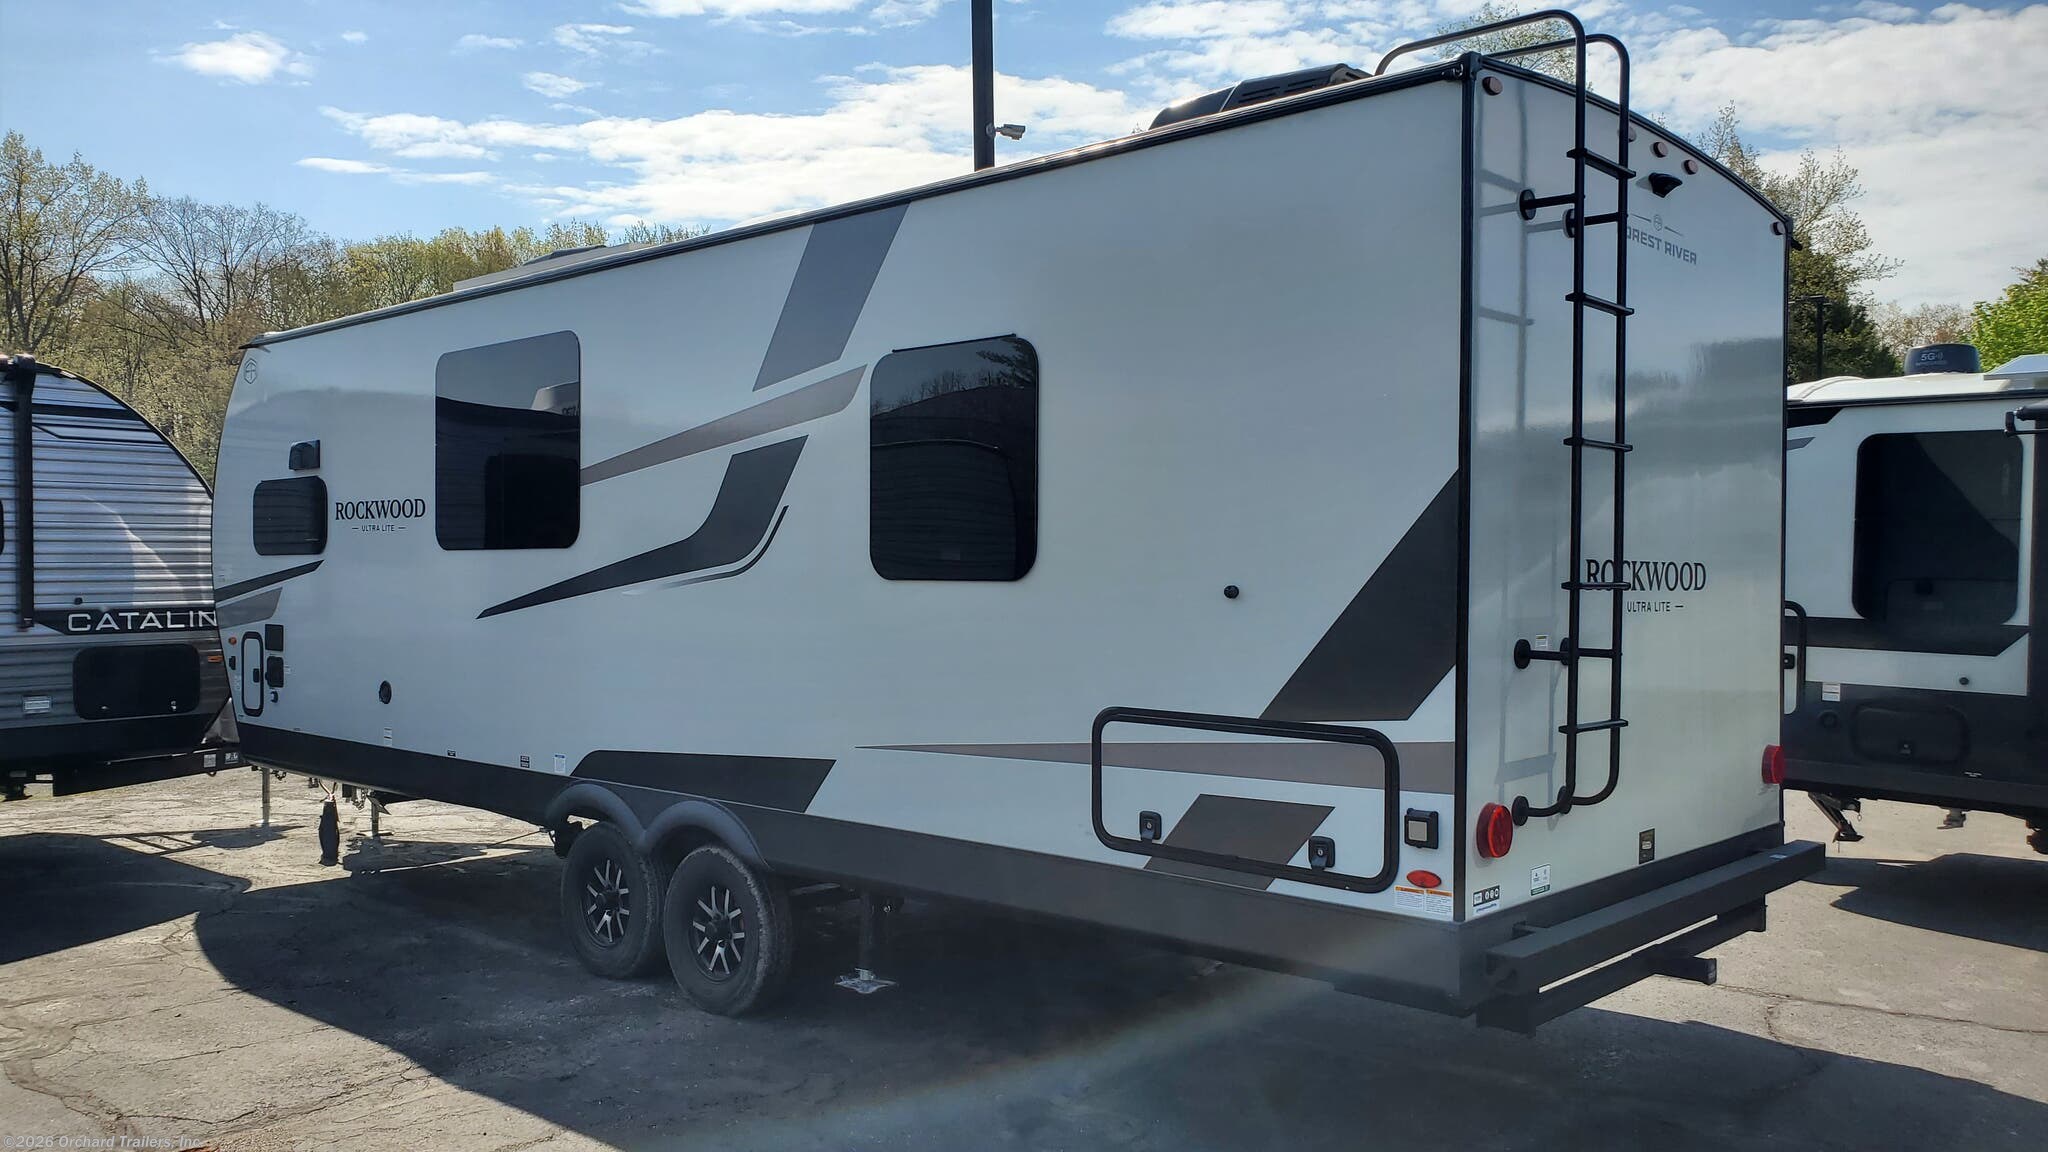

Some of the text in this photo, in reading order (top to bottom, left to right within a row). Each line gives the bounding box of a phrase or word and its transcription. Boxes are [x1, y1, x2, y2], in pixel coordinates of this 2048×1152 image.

[1627, 226, 1697, 265] OREST RIVER
[335, 498, 426, 520] ROCKWOOD
[382, 524, 395, 532] LITE
[1627, 601, 1671, 613] ULTRA LITE
[67, 610, 218, 632] CATALIN
